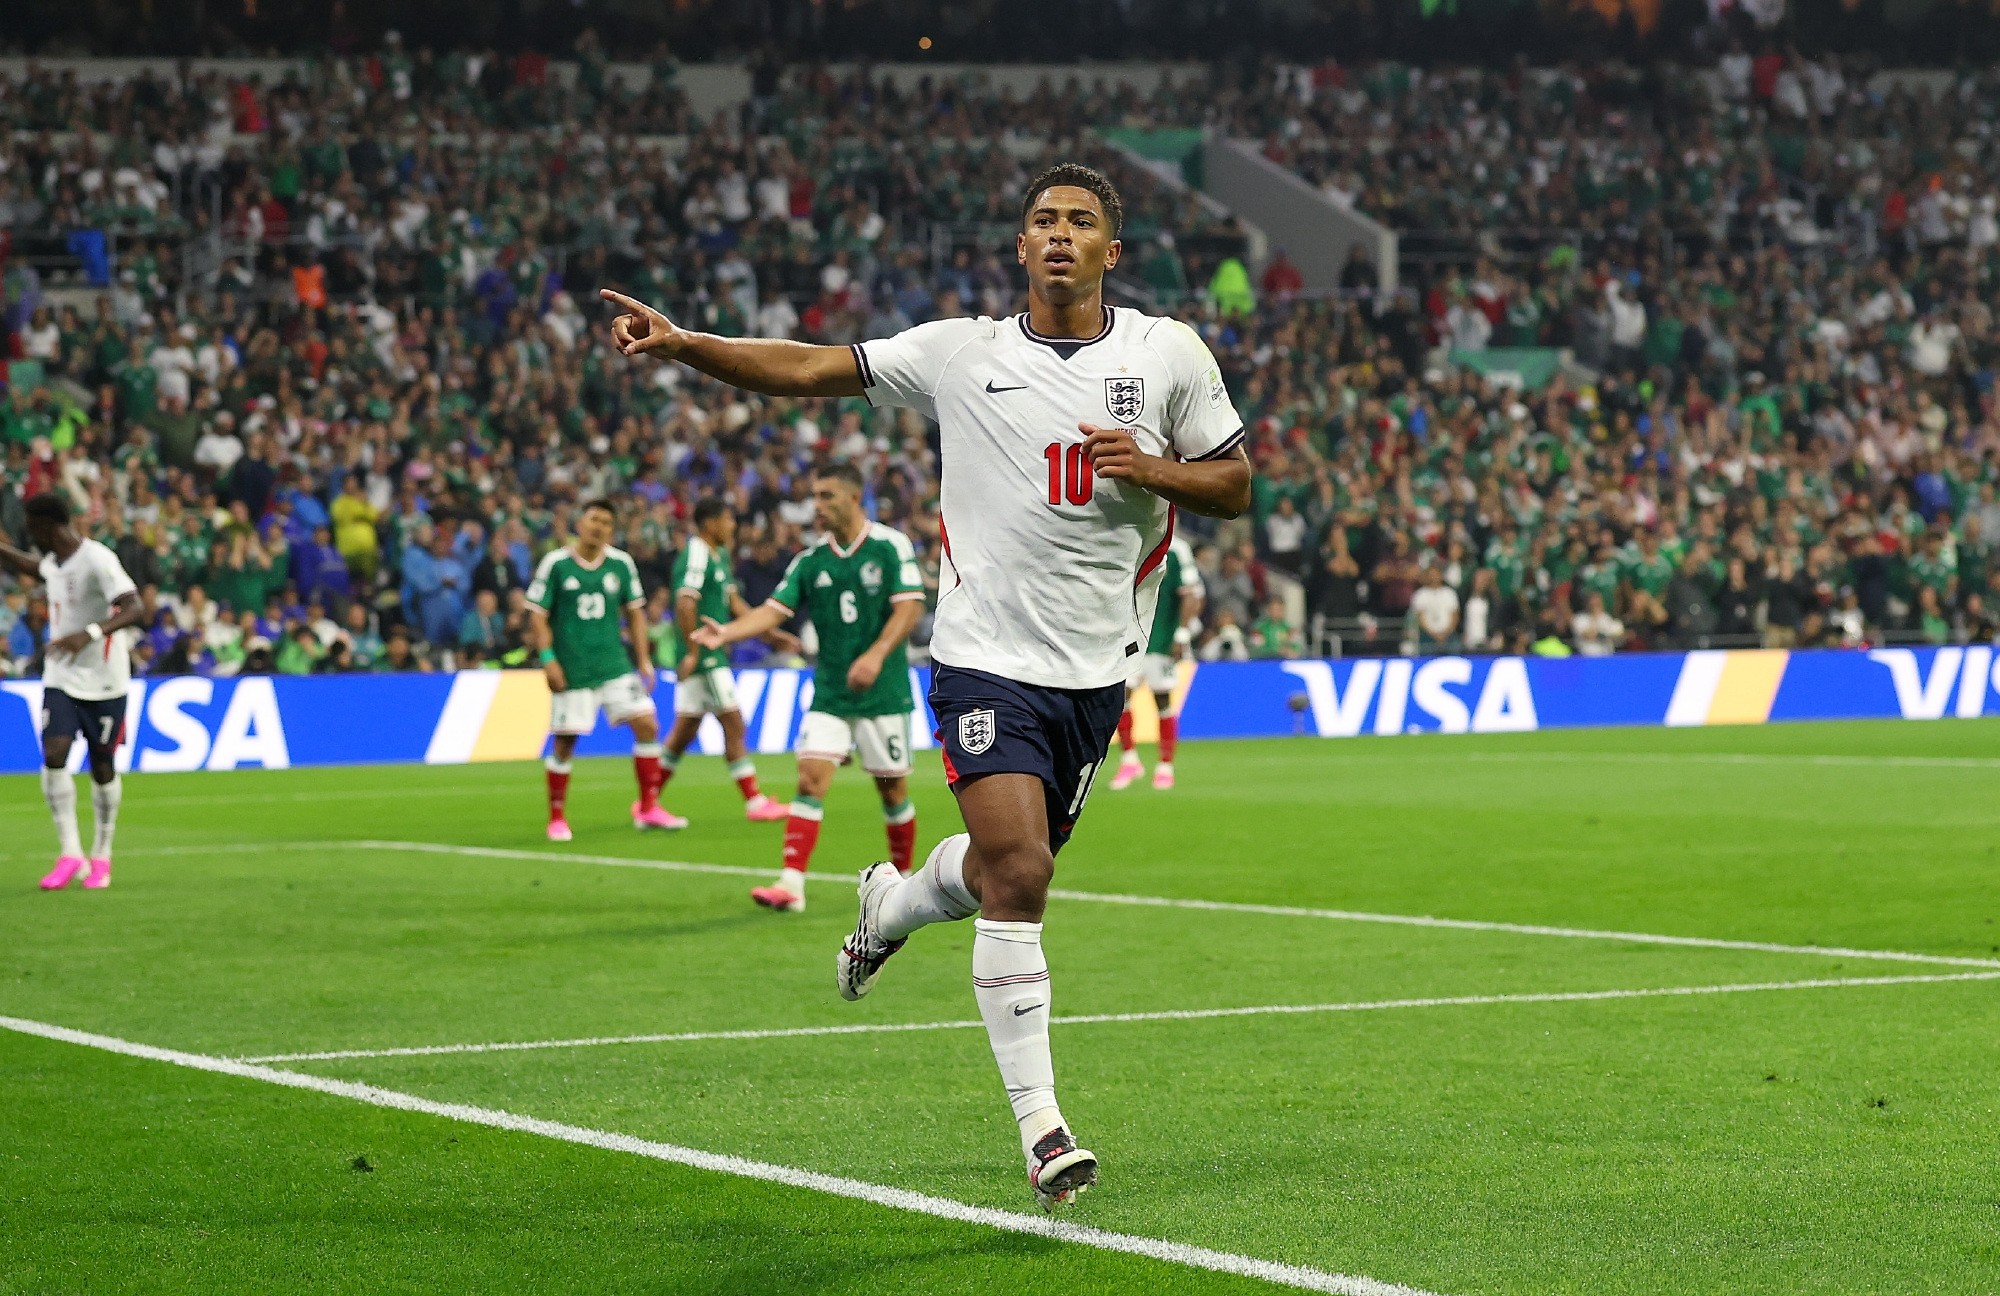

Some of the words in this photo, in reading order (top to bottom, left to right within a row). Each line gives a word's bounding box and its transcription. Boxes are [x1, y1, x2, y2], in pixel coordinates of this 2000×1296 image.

[1044, 442, 1094, 506] 10
[577, 592, 606, 621] 23
[839, 590, 859, 624] 6
[1280, 656, 1539, 737] VISA
[1866, 645, 2000, 719] VI
[100, 715, 114, 744] 7
[888, 735, 901, 761] 6
